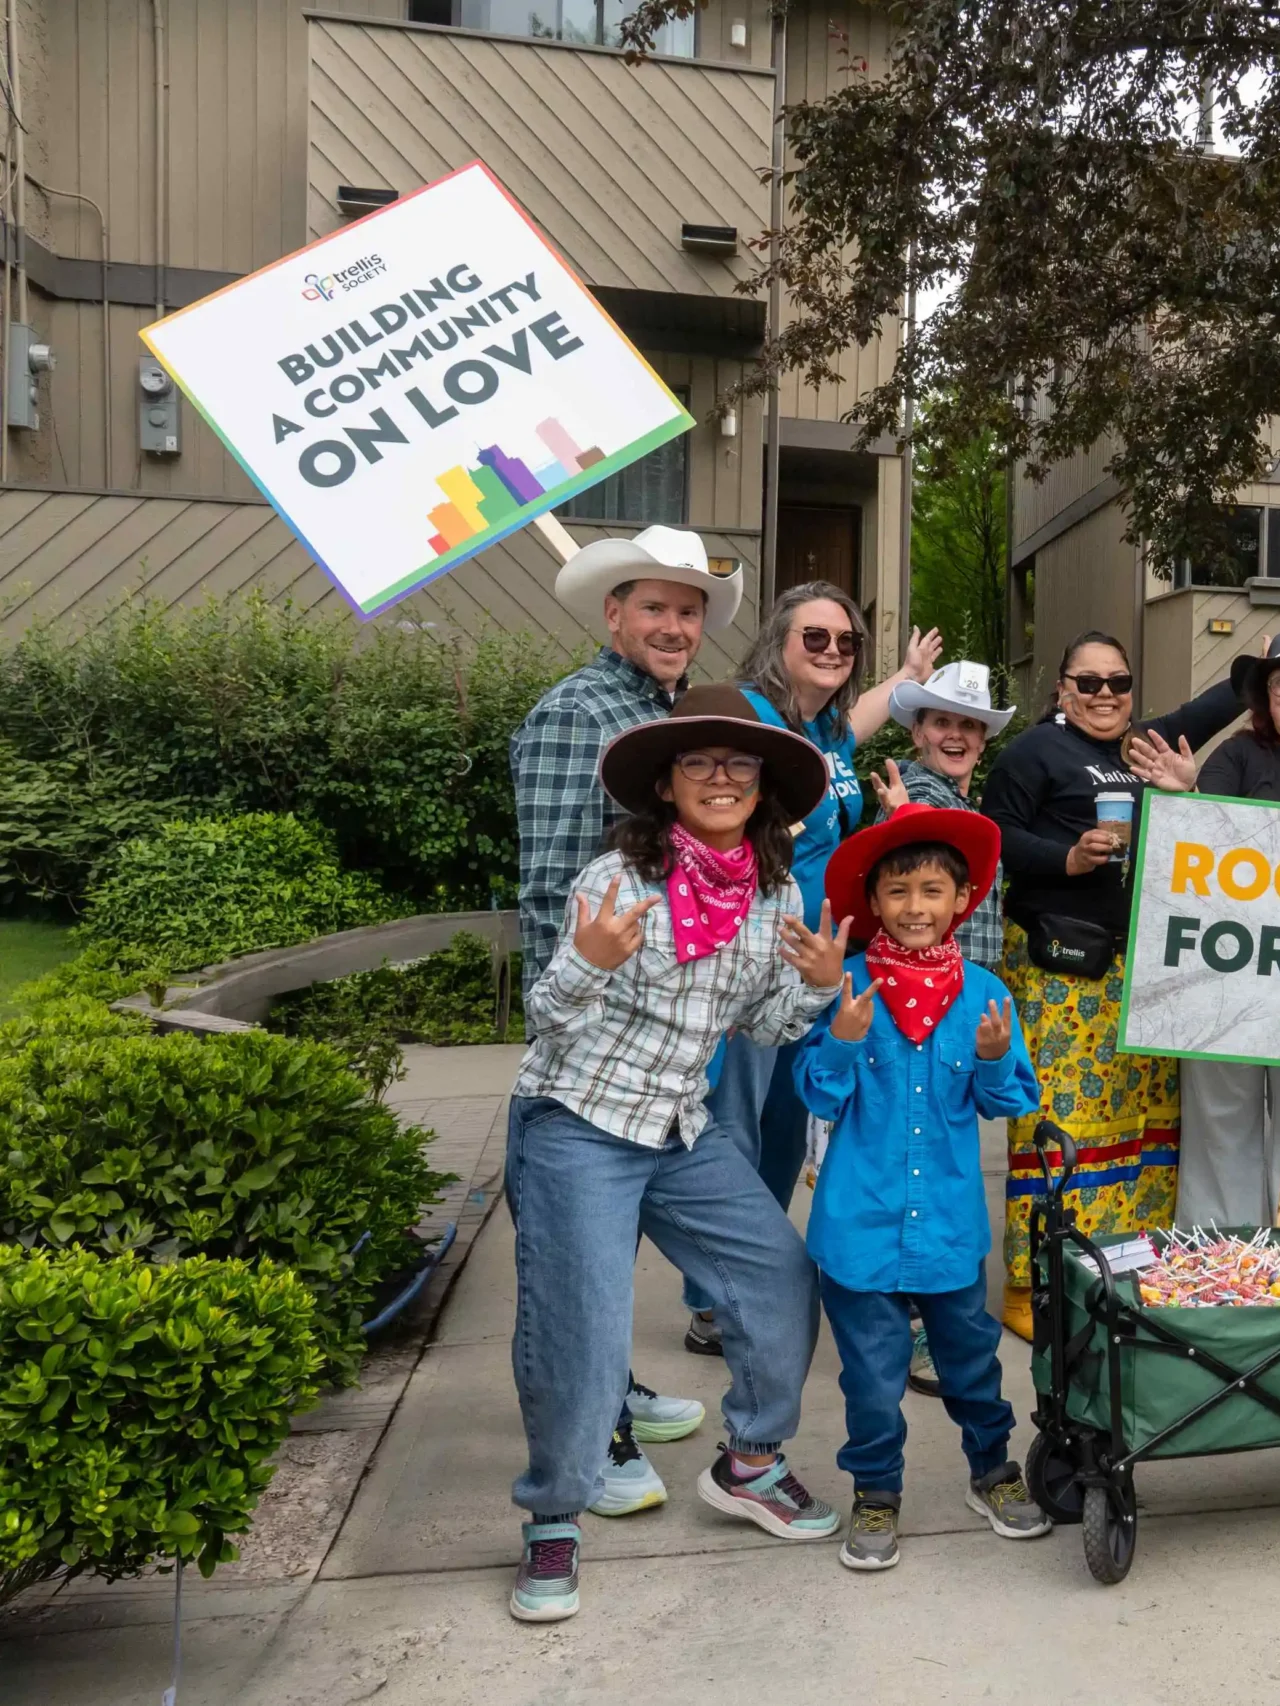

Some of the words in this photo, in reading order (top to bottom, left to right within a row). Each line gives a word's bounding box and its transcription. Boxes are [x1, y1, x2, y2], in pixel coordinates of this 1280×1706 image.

[332, 254, 382, 284] trellis
[341, 263, 388, 292] SOCIETY
[278, 263, 482, 386] BUILDING
[272, 413, 304, 444] A
[304, 272, 542, 418] COMMUNITY
[299, 407, 410, 488] ON
[405, 311, 585, 429] LOVE
[716, 560, 723, 571] 7
[1083, 764, 1140, 786] Native
[1062, 946, 1086, 958] trellis
